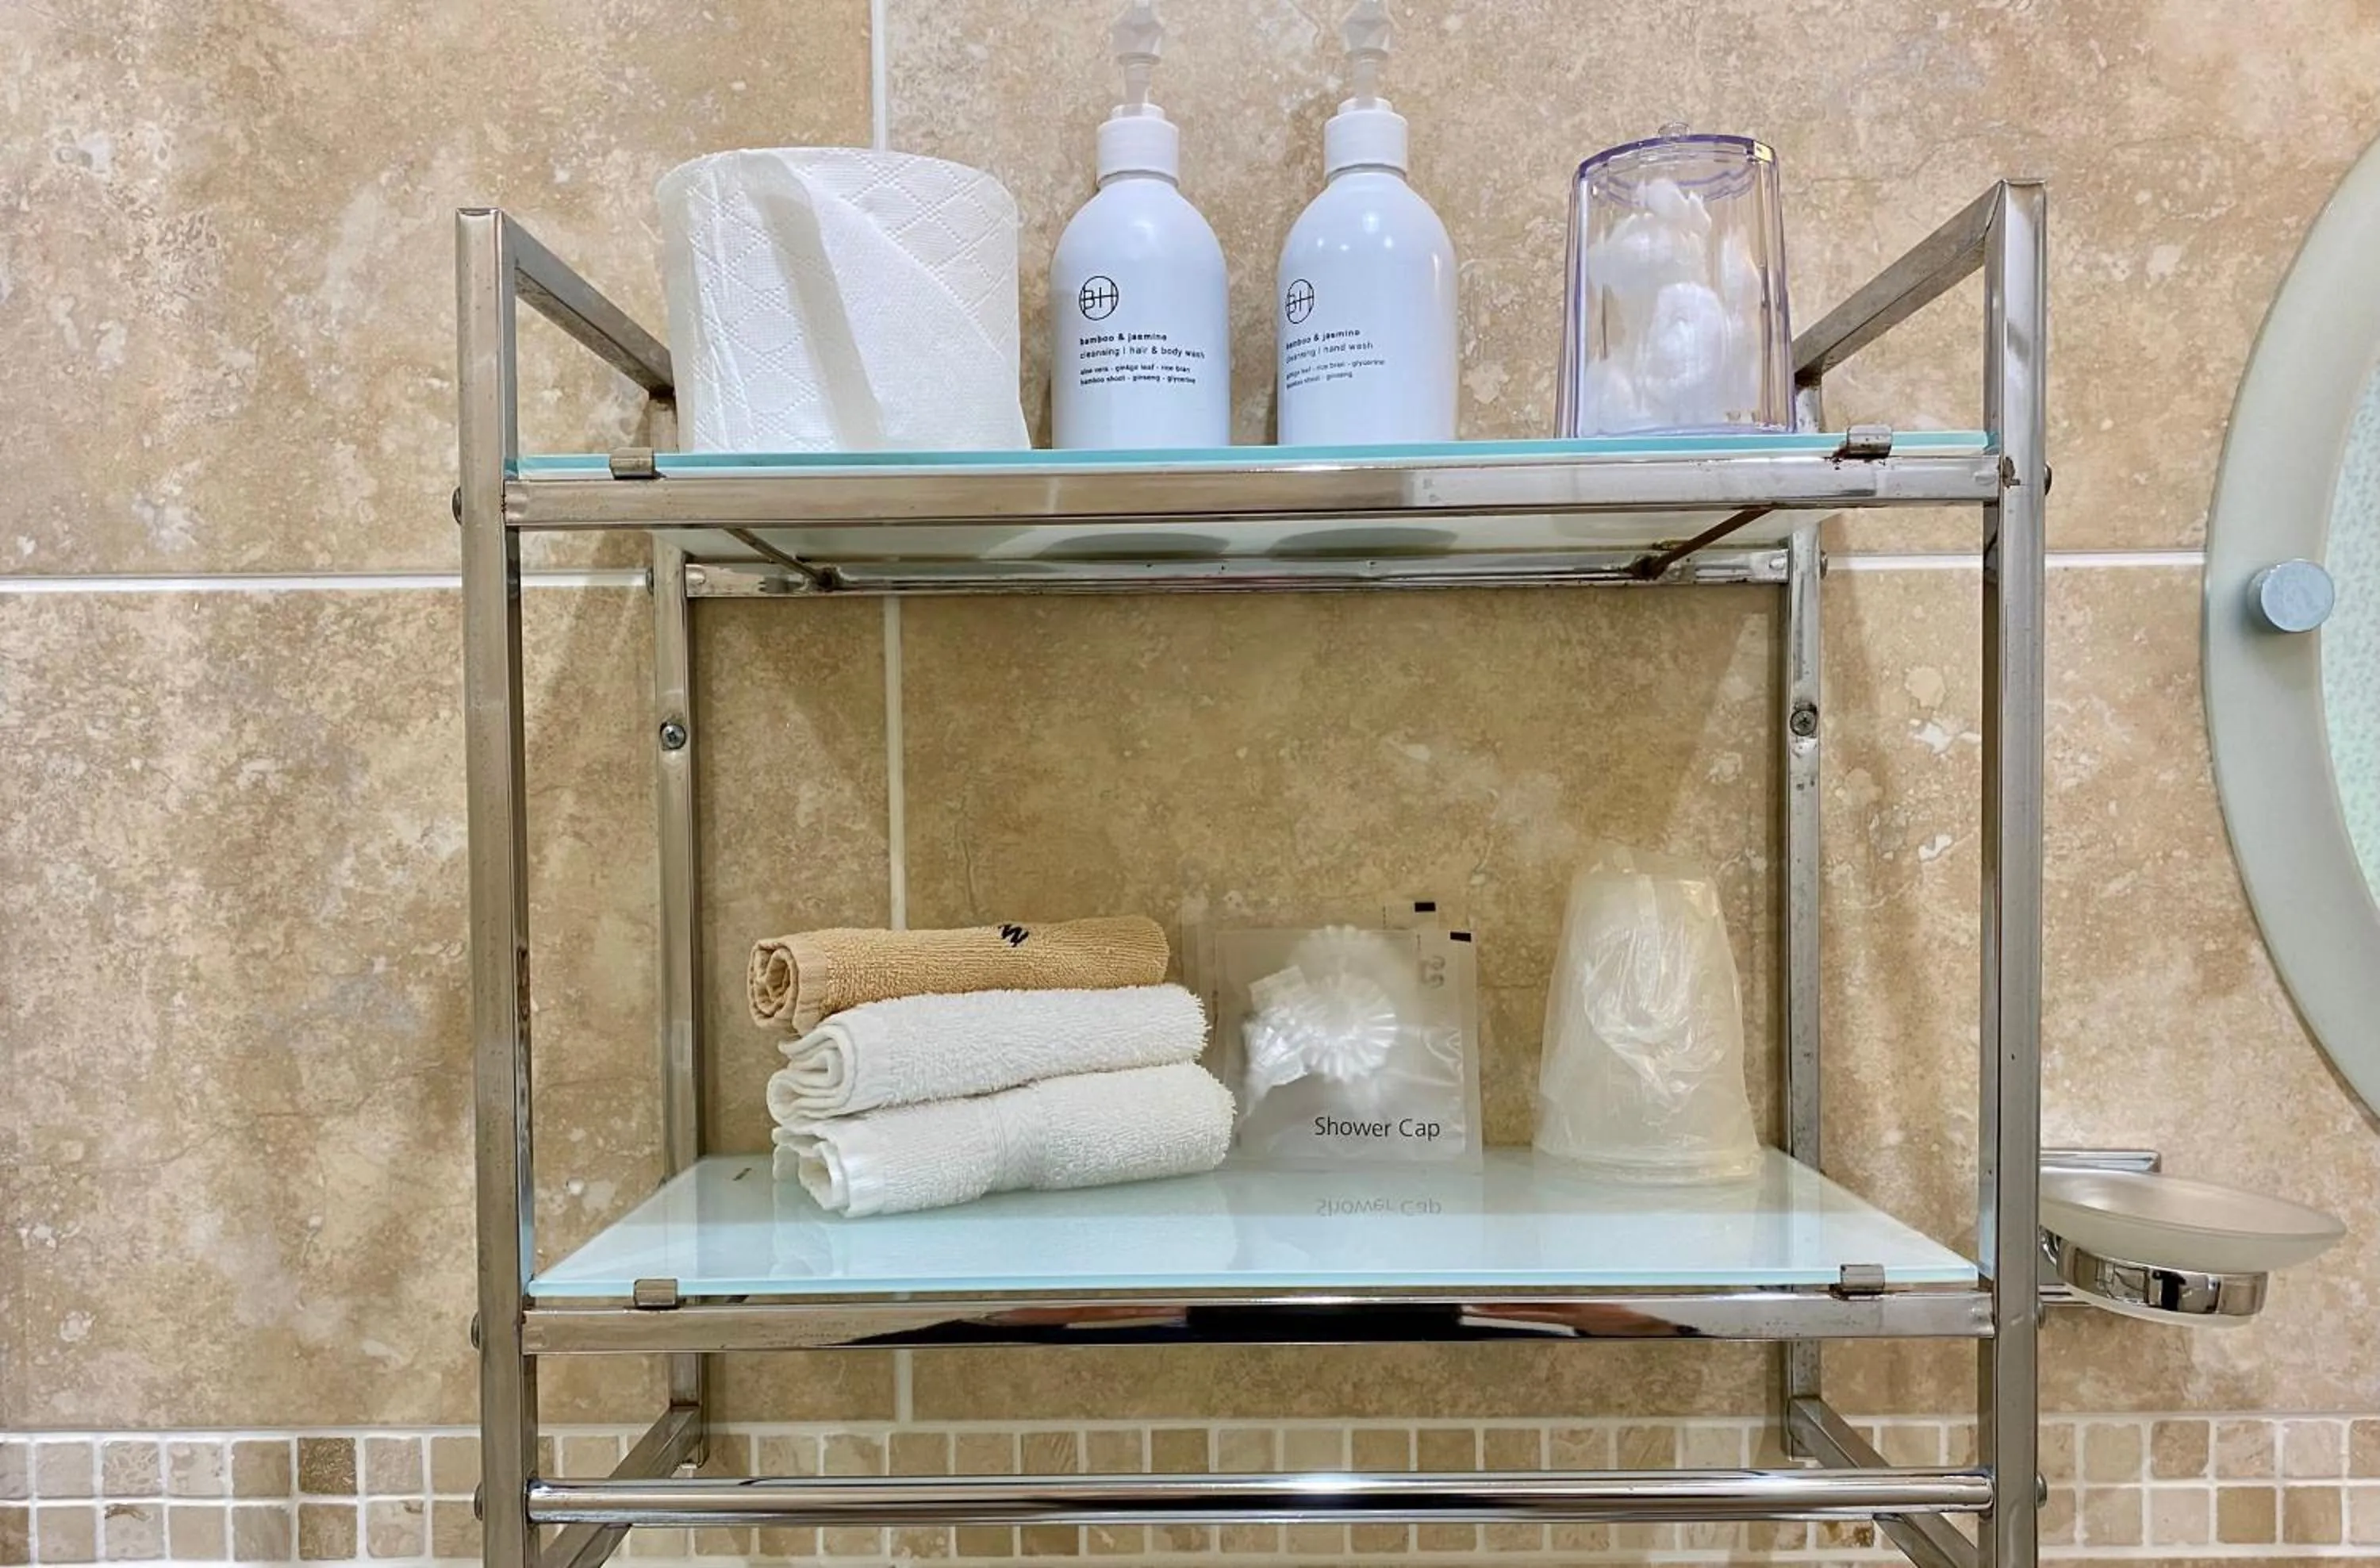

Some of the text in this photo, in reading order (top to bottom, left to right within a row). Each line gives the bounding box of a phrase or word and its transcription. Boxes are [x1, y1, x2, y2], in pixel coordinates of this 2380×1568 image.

[1080, 332, 1167, 346] bamboo & jasmine
[1322, 329, 1361, 342] jasmine
[1080, 348, 1120, 359] cleansing
[1129, 346, 1148, 355] hair
[1151, 345, 1158, 355] &
[1161, 346, 1183, 358] body
[1348, 340, 1373, 350] wash
[1315, 1115, 1441, 1141] Shower Cap
